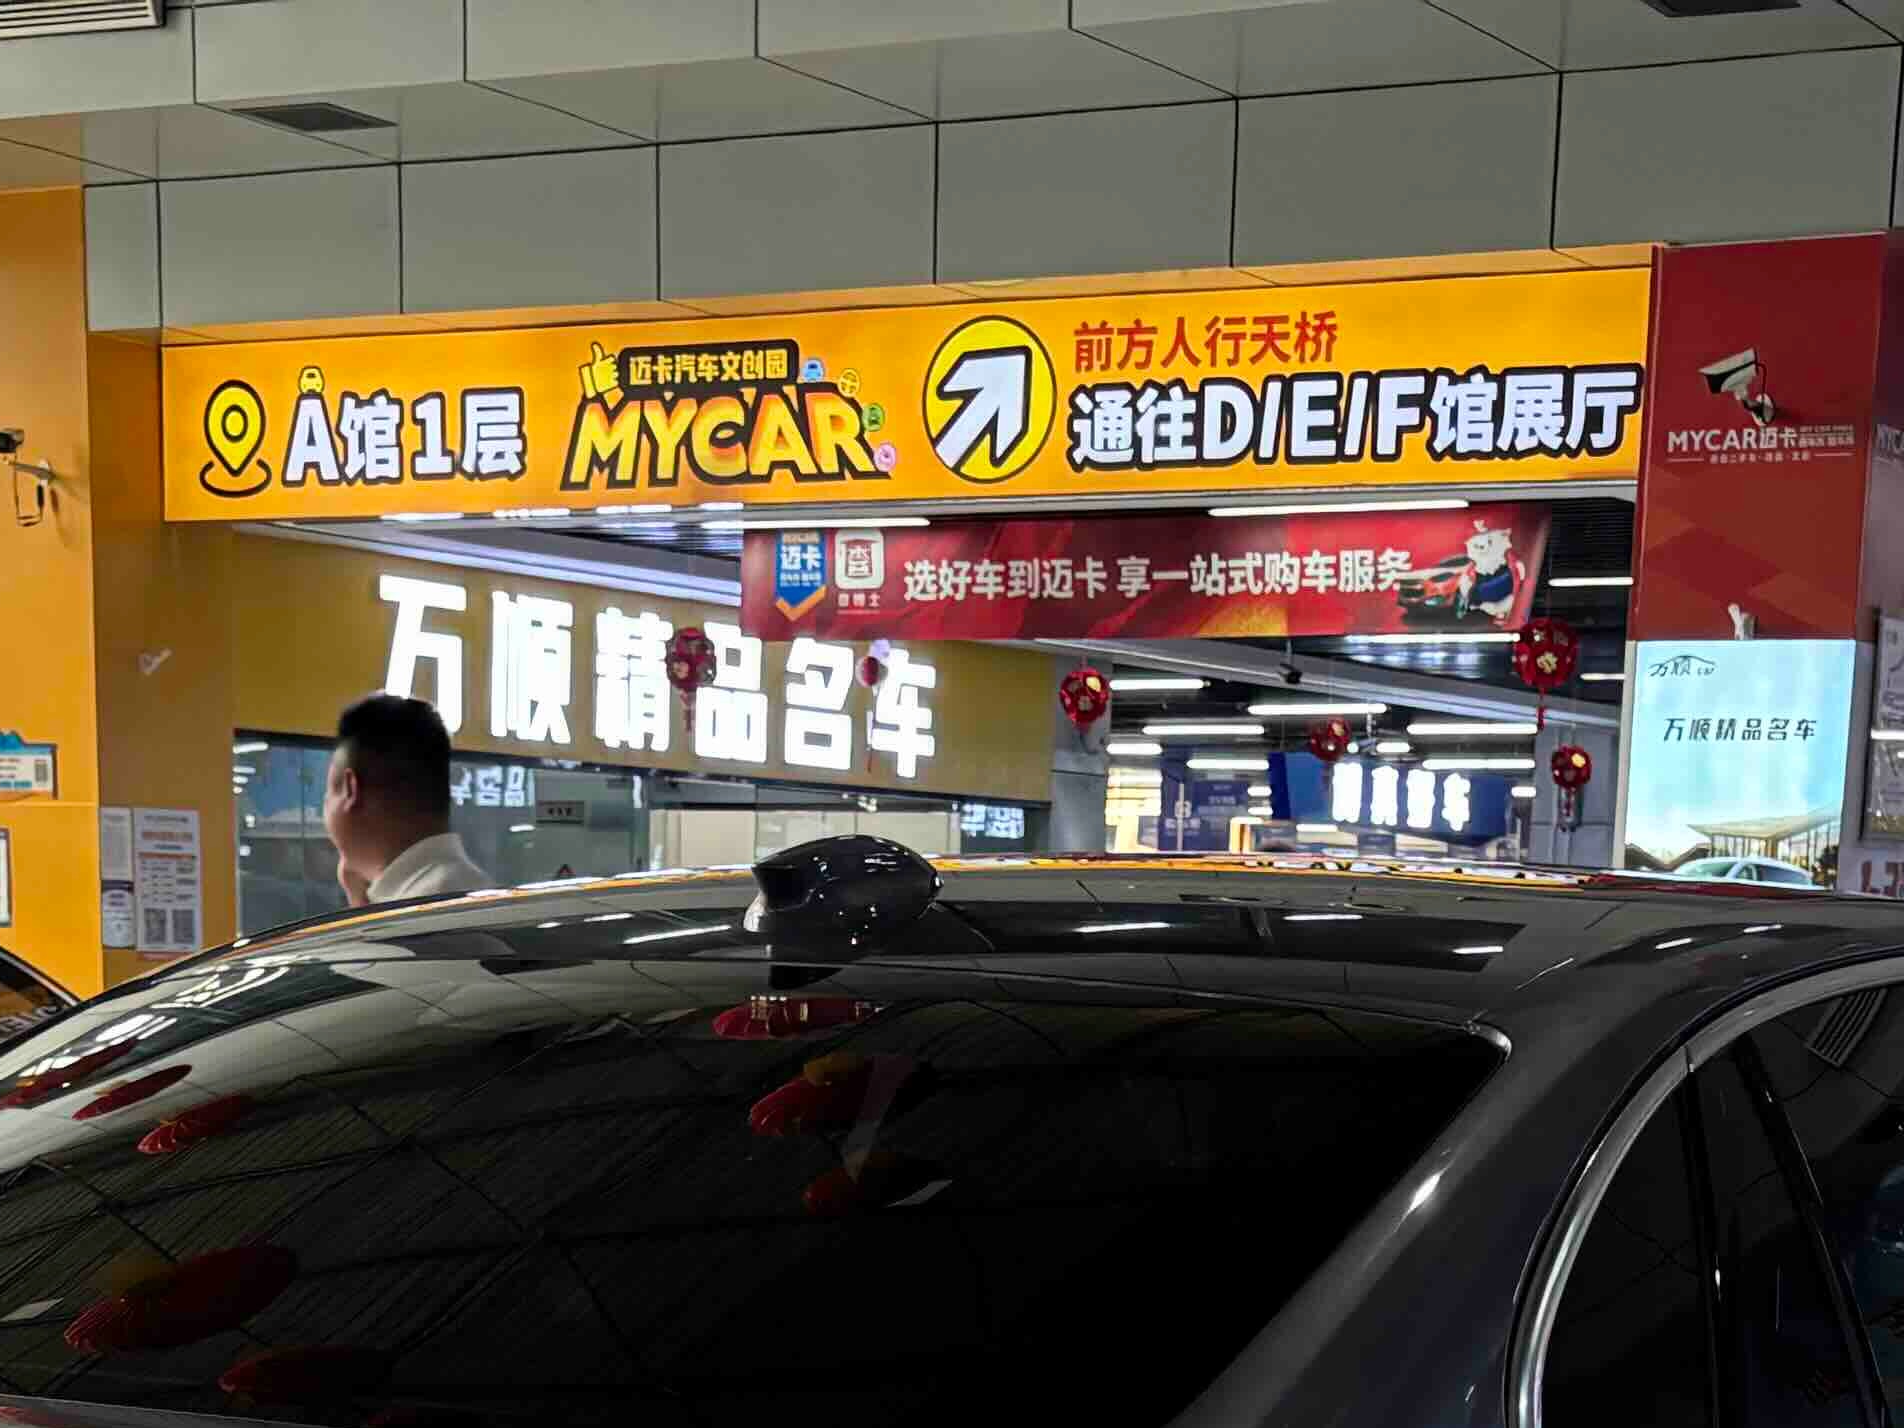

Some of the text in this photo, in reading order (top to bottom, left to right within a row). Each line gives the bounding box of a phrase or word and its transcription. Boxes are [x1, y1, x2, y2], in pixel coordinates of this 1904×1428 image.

[628, 349, 789, 382] 迈卡汽车文创园
[1073, 310, 1338, 372] 前方人行天桥
[285, 391, 524, 484] A馆1层
[566, 388, 875, 487] MYCAR
[1072, 369, 1638, 467] 通往D/E/F馆展厅
[904, 548, 1412, 601] 选好车到迈卡 享一站式购车服务
[378, 574, 938, 779] 万顺精品名车
[1663, 717, 1818, 742] 万顺精品名车
